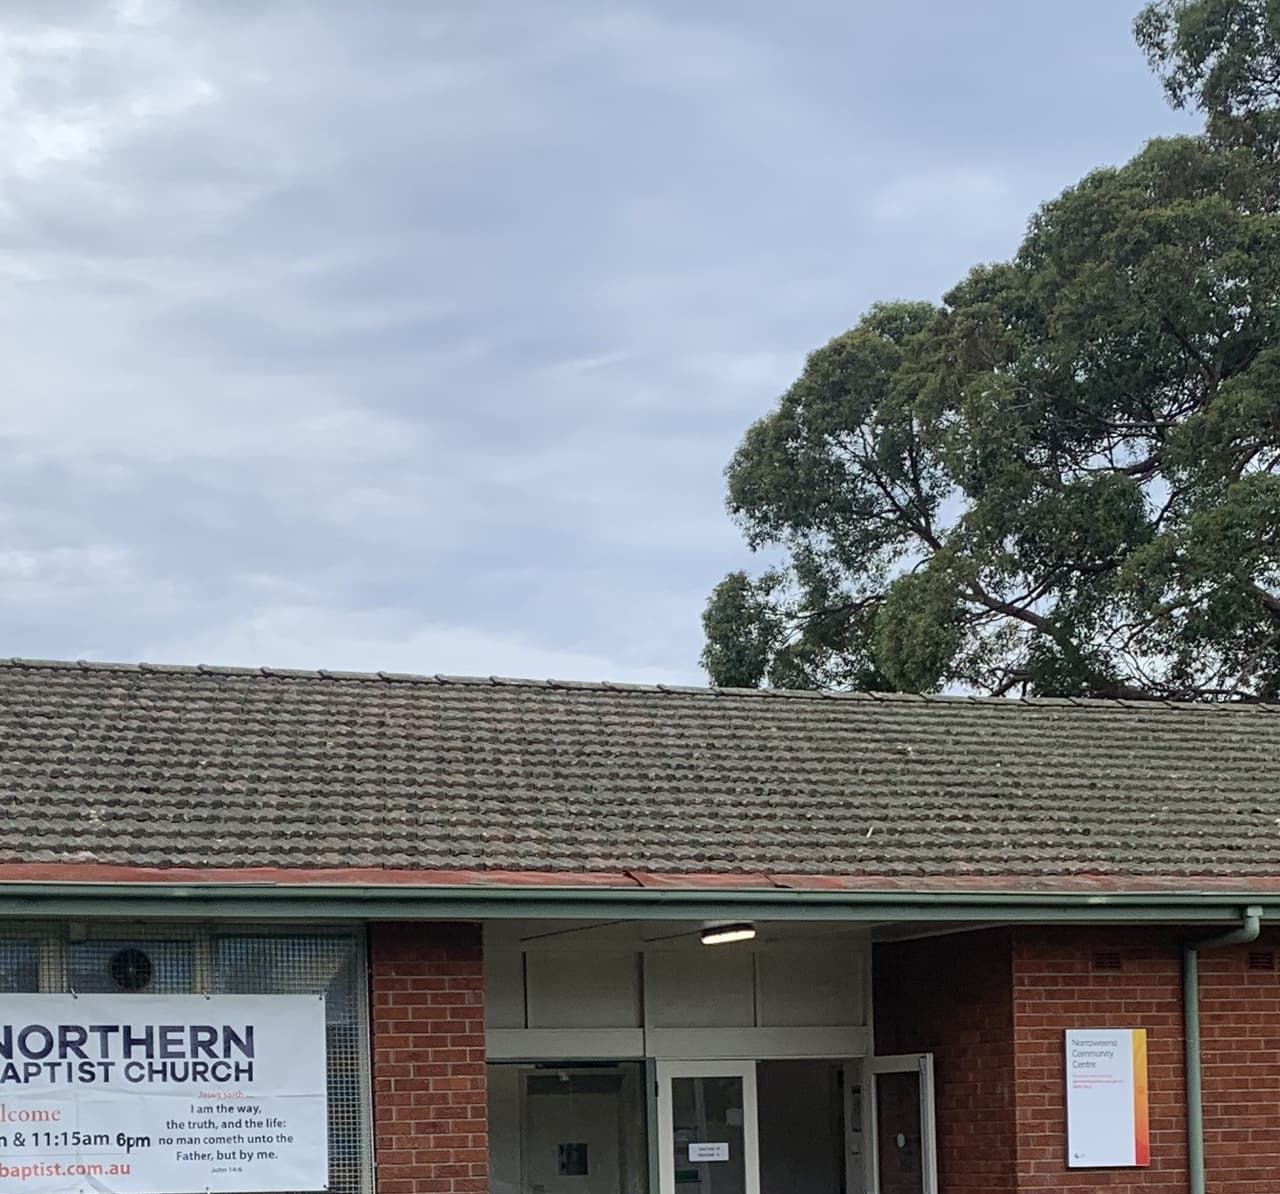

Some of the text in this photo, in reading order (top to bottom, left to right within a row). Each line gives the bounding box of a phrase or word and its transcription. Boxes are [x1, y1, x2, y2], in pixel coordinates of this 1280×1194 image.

[124, 1061, 254, 1083] CHURCH
[190, 1104, 194, 1113] I
[216, 1104, 234, 1113] the
[237, 1105, 261, 1115] way,
[166, 1118, 286, 1129] the truth, and the life:
[13, 1132, 26, 1146] &
[32, 1131, 109, 1146] 11:15am
[116, 1132, 150, 1153] 6pm
[158, 1133, 294, 1145] no man cometh unto the
[176, 1149, 278, 1162] Father, but by me.
